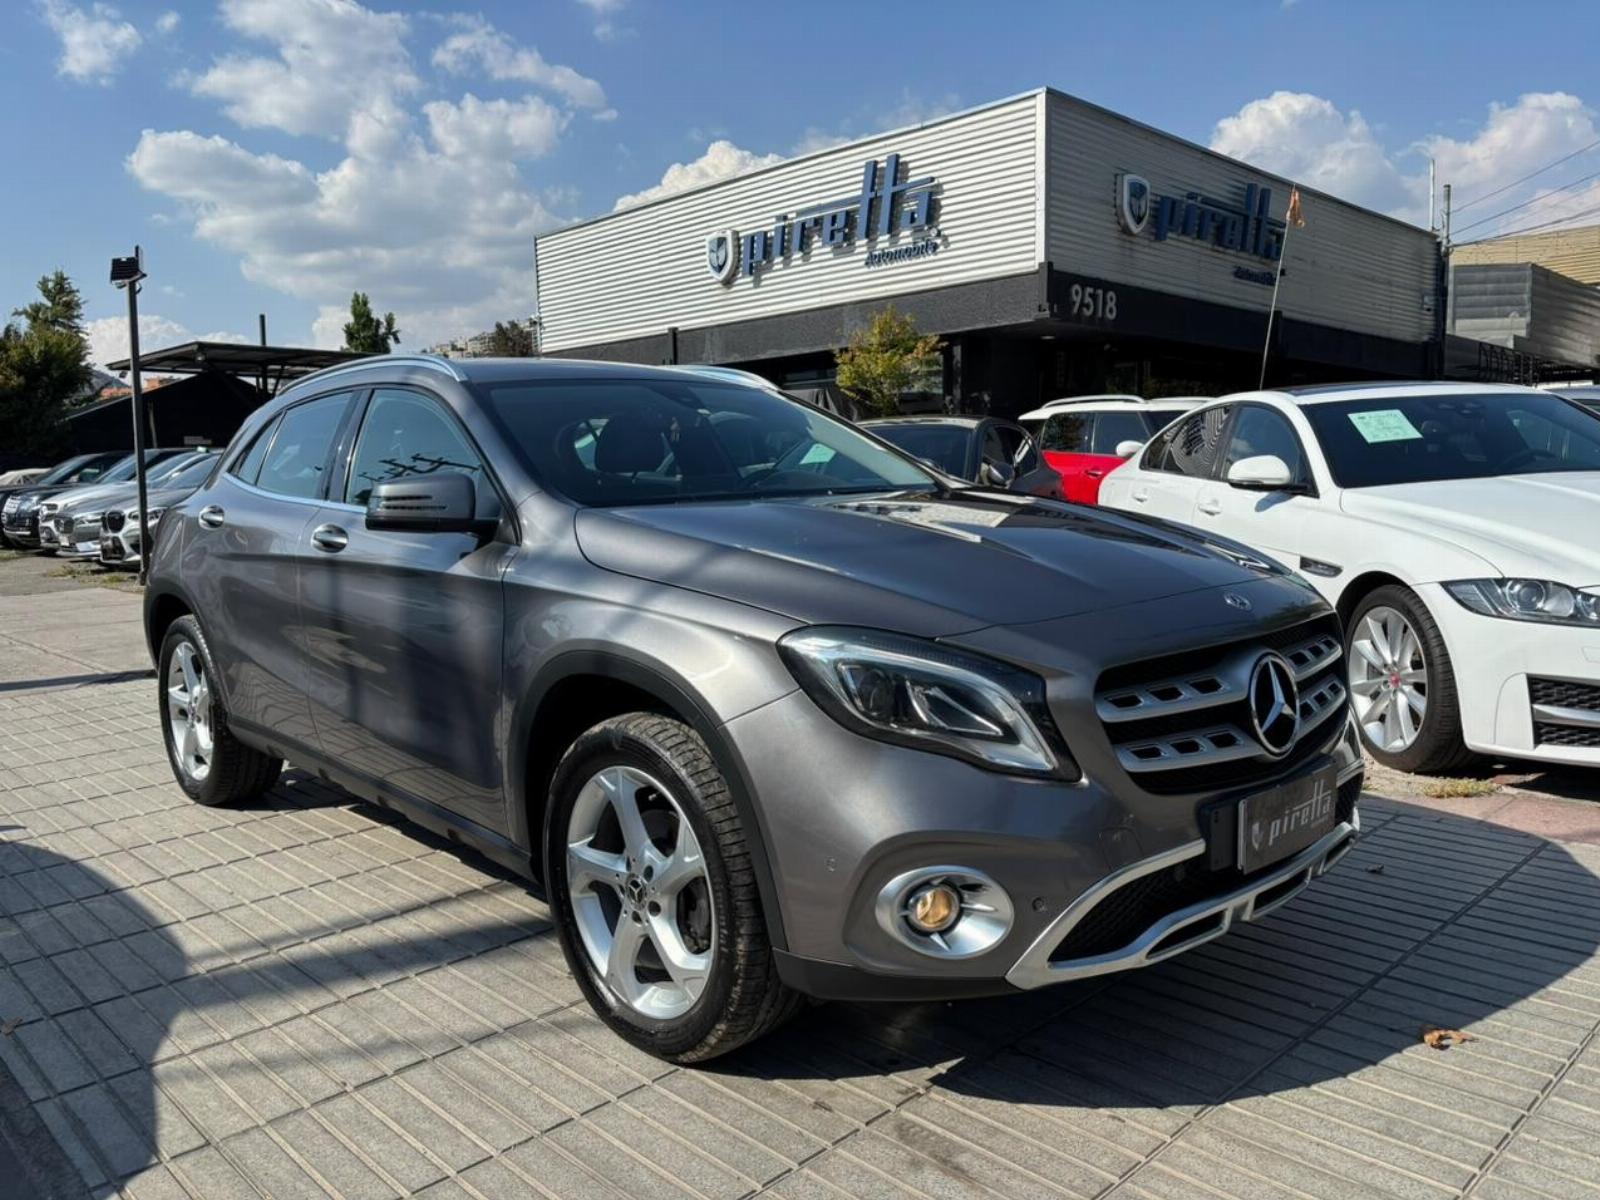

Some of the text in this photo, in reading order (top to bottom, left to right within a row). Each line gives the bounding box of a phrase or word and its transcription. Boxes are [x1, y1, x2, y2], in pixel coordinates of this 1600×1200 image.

[742, 154, 936, 276] piretta
[1070, 284, 1118, 321] 9518
[1268, 779, 1332, 846] piretta
